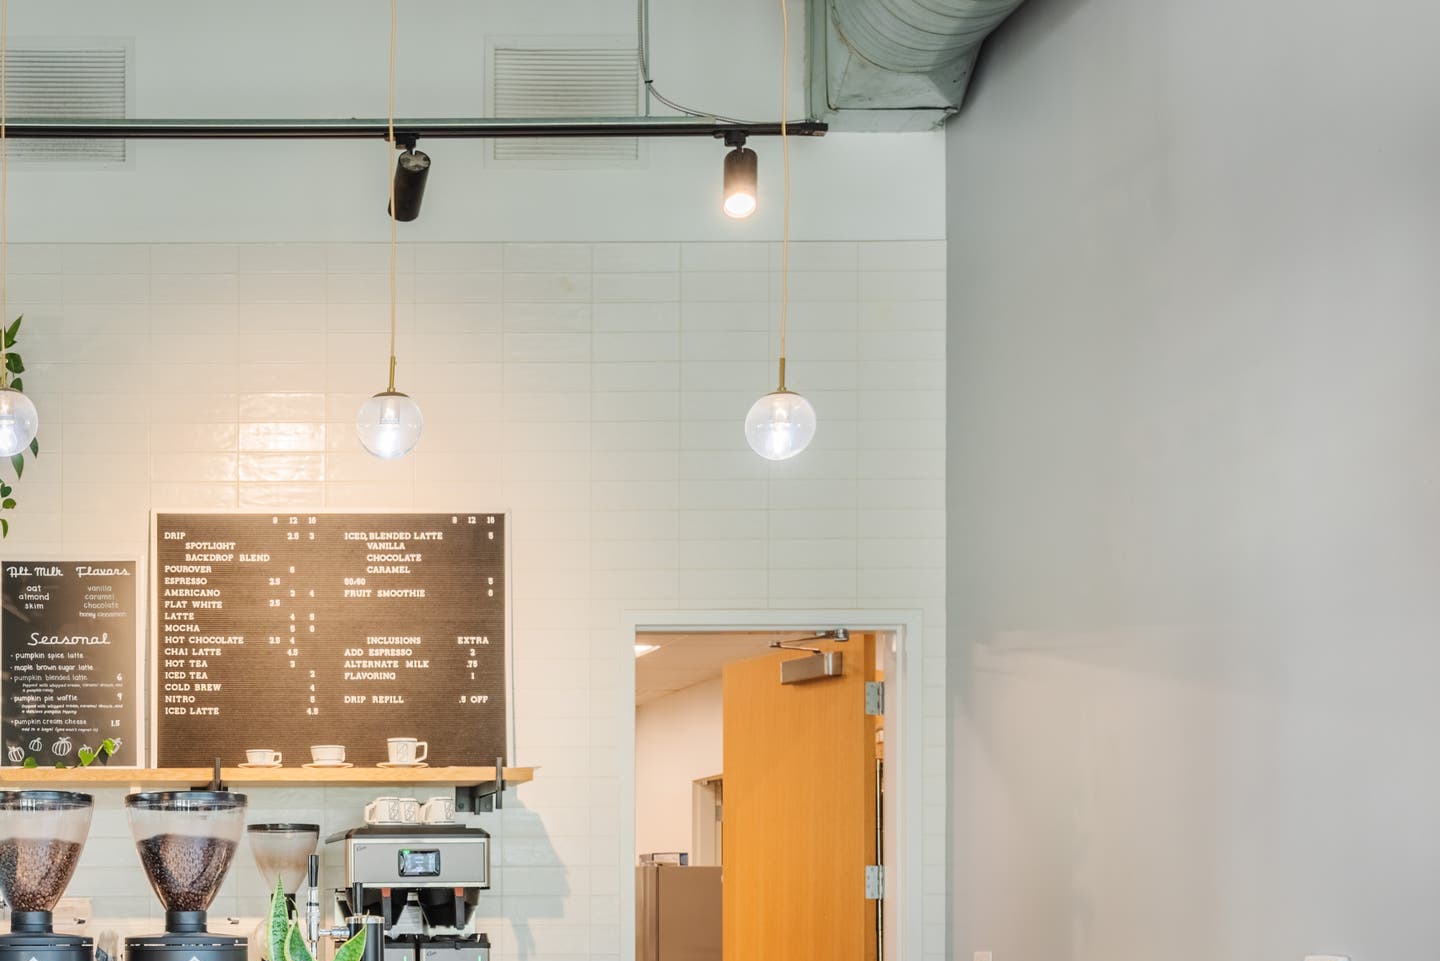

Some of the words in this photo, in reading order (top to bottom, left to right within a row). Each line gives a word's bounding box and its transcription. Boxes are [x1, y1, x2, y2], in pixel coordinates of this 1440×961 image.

[289, 516, 298, 525] 12
[308, 516, 317, 525] 16
[467, 516, 477, 525] 12
[164, 532, 186, 540] DRIP
[369, 531, 411, 541] BLENDED
[413, 531, 443, 541] LATTE
[185, 542, 236, 550] SPOTLIGHT
[367, 542, 405, 550] VANILLA
[185, 554, 234, 562] BACKDROP
[239, 554, 270, 562] BLEND
[366, 554, 422, 562] CHOCOLATE
[6, 566, 32, 578] Alt
[34, 566, 64, 577] Milk
[75, 566, 131, 578] Flavors
[164, 565, 212, 573] POUROVER
[366, 566, 410, 574] CARAMEL
[164, 577, 207, 585] ESPRESSO
[26, 584, 42, 592] oat
[87, 584, 112, 592] vanilla
[18, 593, 50, 601] almond
[164, 589, 220, 597] AMERICANO
[309, 589, 315, 597] 4
[344, 589, 372, 597] FRUIT
[377, 589, 426, 597] SMOOTHIE
[24, 602, 44, 610] skim
[164, 600, 188, 609] FLAT
[192, 600, 223, 609] WHITE
[164, 613, 194, 621] LATTE
[289, 613, 296, 621] 4
[165, 625, 200, 633] MOCHA
[27, 632, 111, 646] Seasonal
[165, 636, 185, 644] HOT
[189, 636, 244, 644] CHOCOLATE
[289, 636, 296, 644] 4
[367, 636, 421, 645] INCLUSIONS
[457, 636, 489, 645] EXTRA
[15, 652, 45, 660] pumpkin
[165, 648, 188, 656] CHAI
[192, 648, 222, 656] LATTE
[344, 648, 364, 656] ADD
[368, 648, 413, 656] ESPRESSO
[14, 664, 33, 672] maple
[58, 664, 76, 672] sugar
[165, 660, 185, 668] HOT
[189, 660, 208, 668] TEA
[344, 660, 399, 668] ALTERNATE
[405, 660, 430, 668] MILK
[14, 674, 42, 683] pumpkin
[116, 673, 123, 681] 6
[165, 671, 186, 679] ICED
[189, 671, 208, 679] TEA
[344, 672, 396, 680] FLAVORING
[164, 683, 190, 691] COLD
[194, 683, 222, 691] BREW
[14, 694, 42, 703] pumpkin
[44, 695, 54, 703] pie
[56, 694, 79, 702] waffle
[116, 692, 123, 701] 9
[165, 695, 196, 703] NITRO
[344, 695, 366, 704] DRIP
[372, 695, 404, 704] REFILL
[470, 695, 488, 704] OFF
[165, 707, 186, 715] ICED
[189, 707, 220, 715] LATTE
[14, 718, 42, 727] pumpkin
